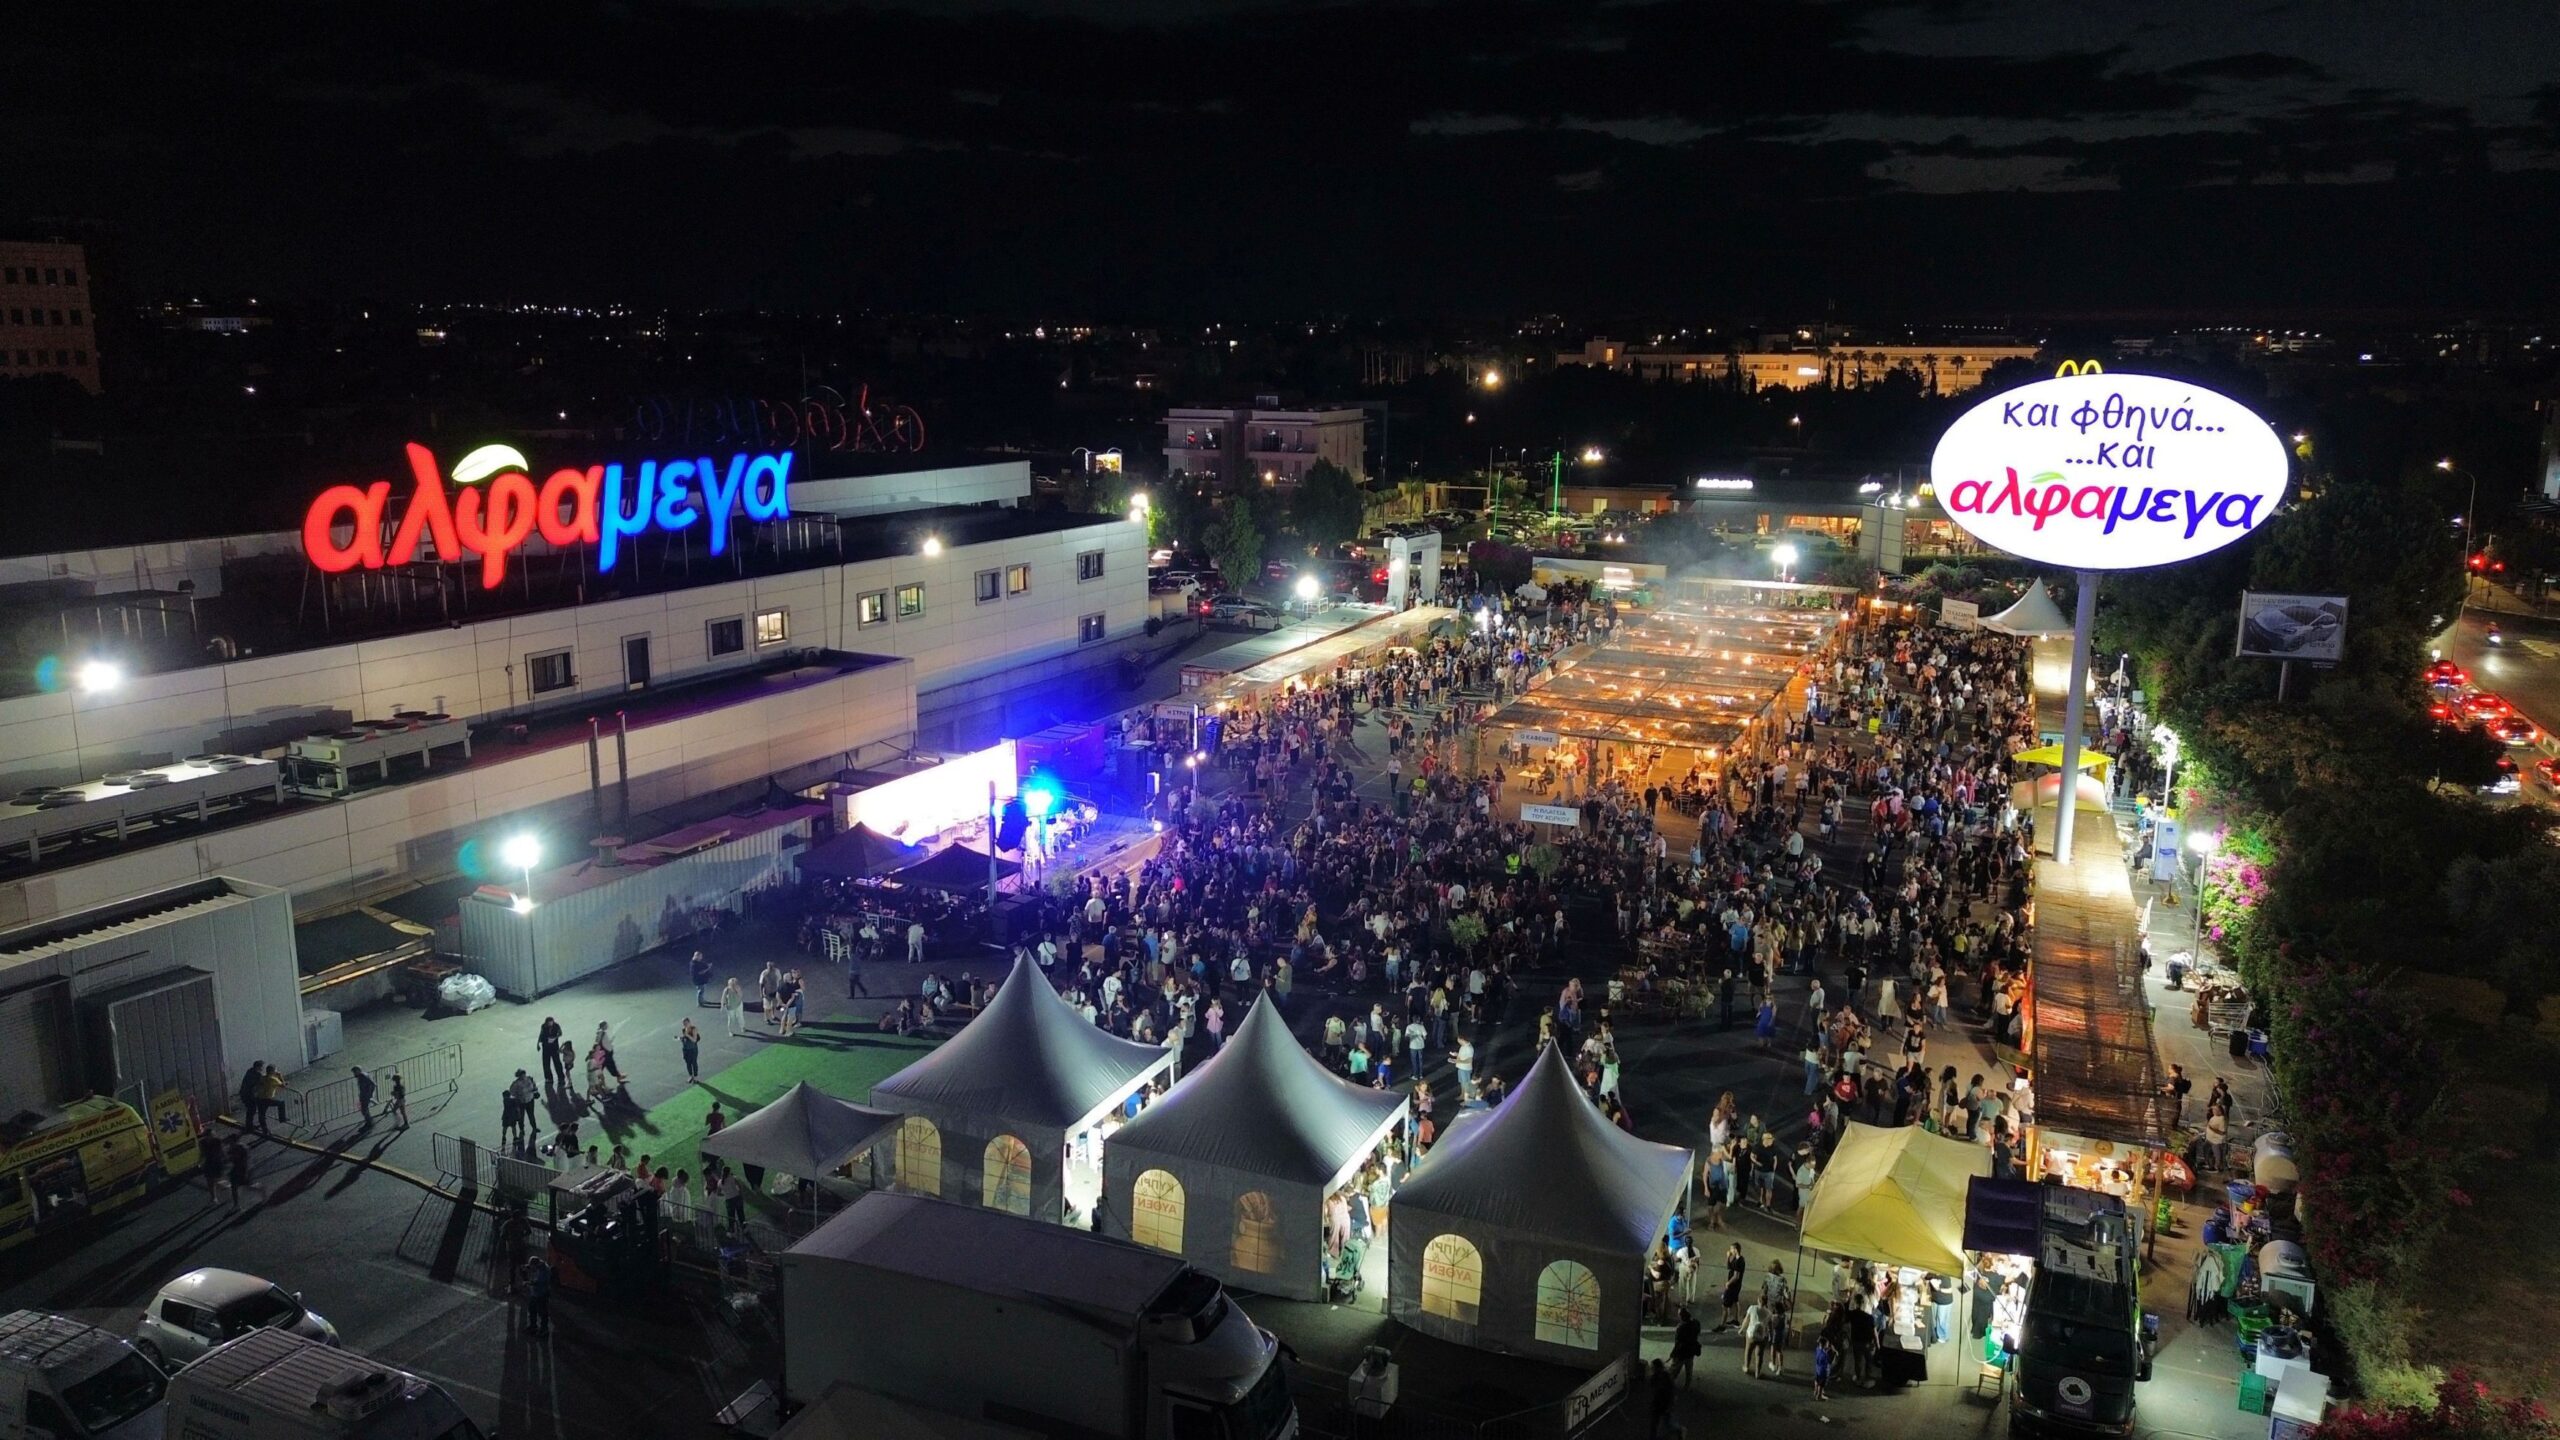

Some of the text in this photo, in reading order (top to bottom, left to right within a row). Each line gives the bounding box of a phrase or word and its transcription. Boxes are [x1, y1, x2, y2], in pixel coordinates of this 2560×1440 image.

[2003, 401, 2059, 428] και
[303, 443, 793, 590] αλφαμεγα
[1949, 467, 2264, 539] αλφαμεγα
